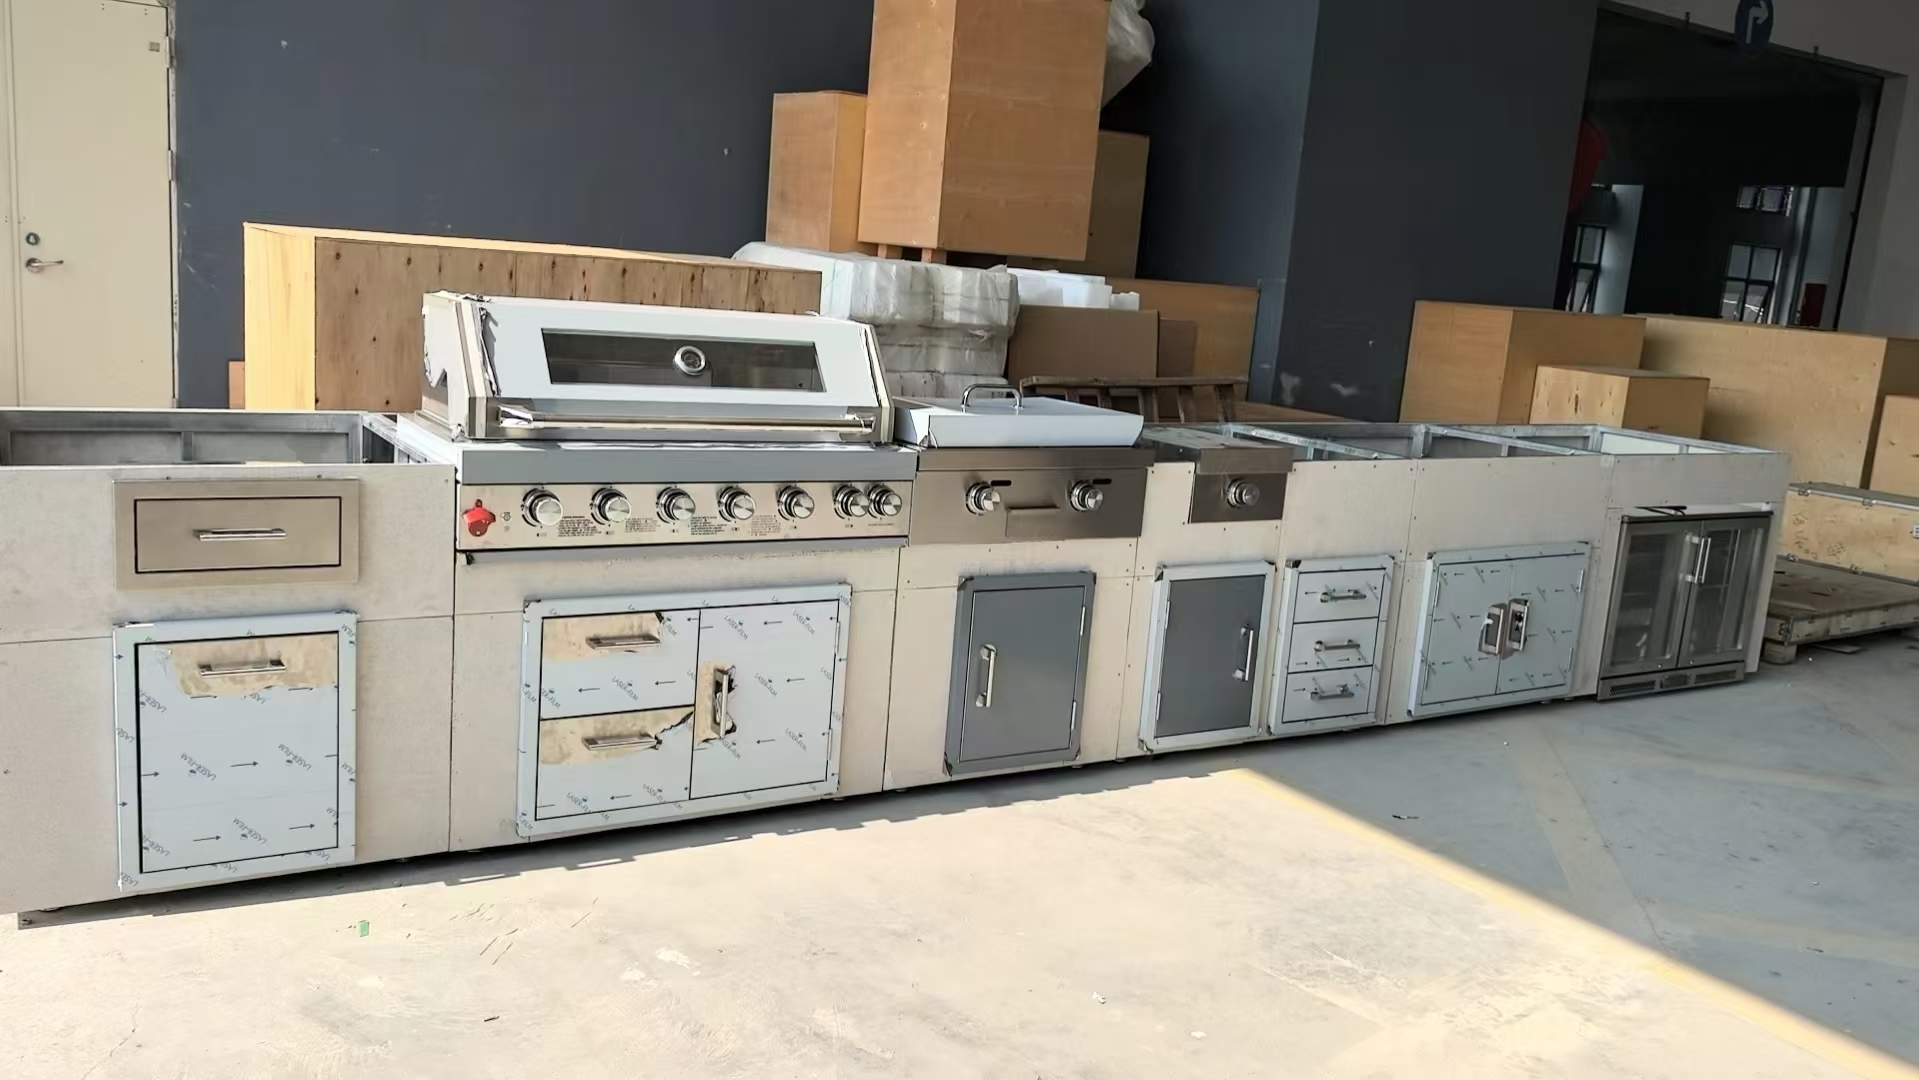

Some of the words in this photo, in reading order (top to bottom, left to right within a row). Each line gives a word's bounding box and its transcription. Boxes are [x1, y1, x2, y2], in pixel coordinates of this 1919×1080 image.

[612, 676, 638, 701] LASER-FILM
[180, 752, 216, 781] LASER-FILM
[278, 744, 312, 771] LASER-FILM
[233, 817, 268, 845] LASER-FILM
